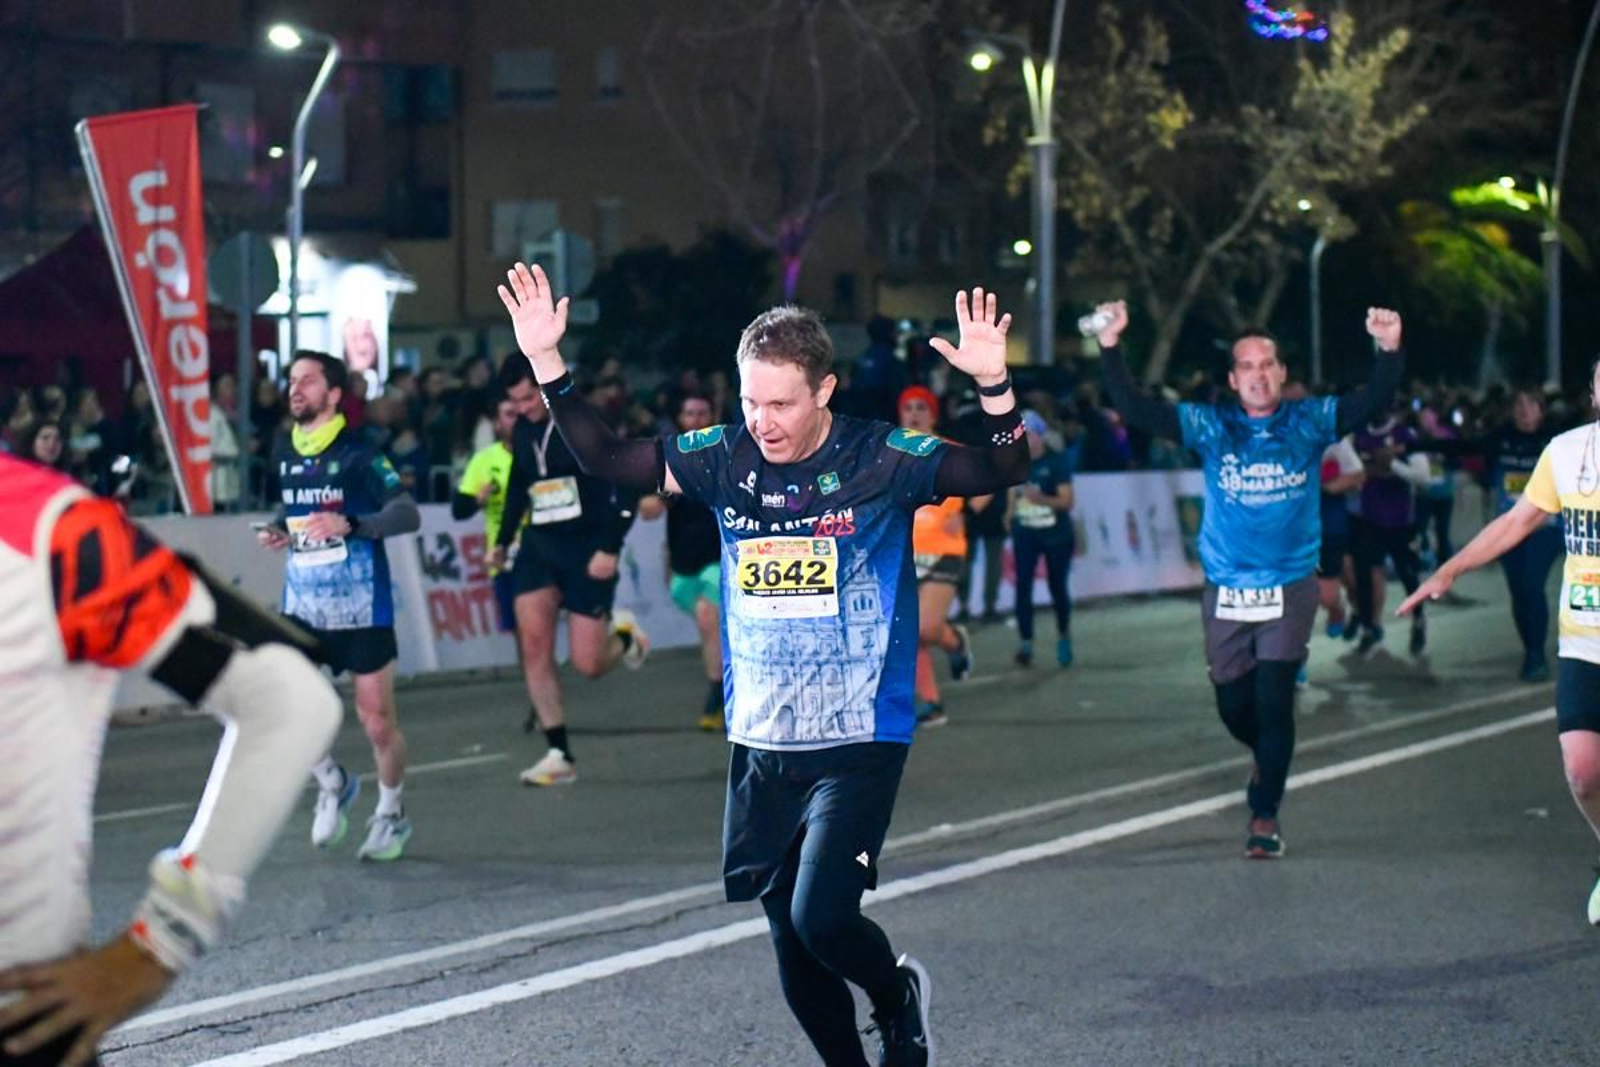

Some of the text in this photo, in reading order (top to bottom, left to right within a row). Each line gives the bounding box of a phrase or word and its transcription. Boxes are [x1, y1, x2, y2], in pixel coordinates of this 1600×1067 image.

[1241, 462, 1285, 477] MEDIA
[1243, 470, 1307, 491] MARATÓN
[296, 485, 344, 504] ANTÓN
[813, 517, 856, 537] 2025
[743, 560, 827, 588] 3642
[427, 587, 495, 642] ANT
